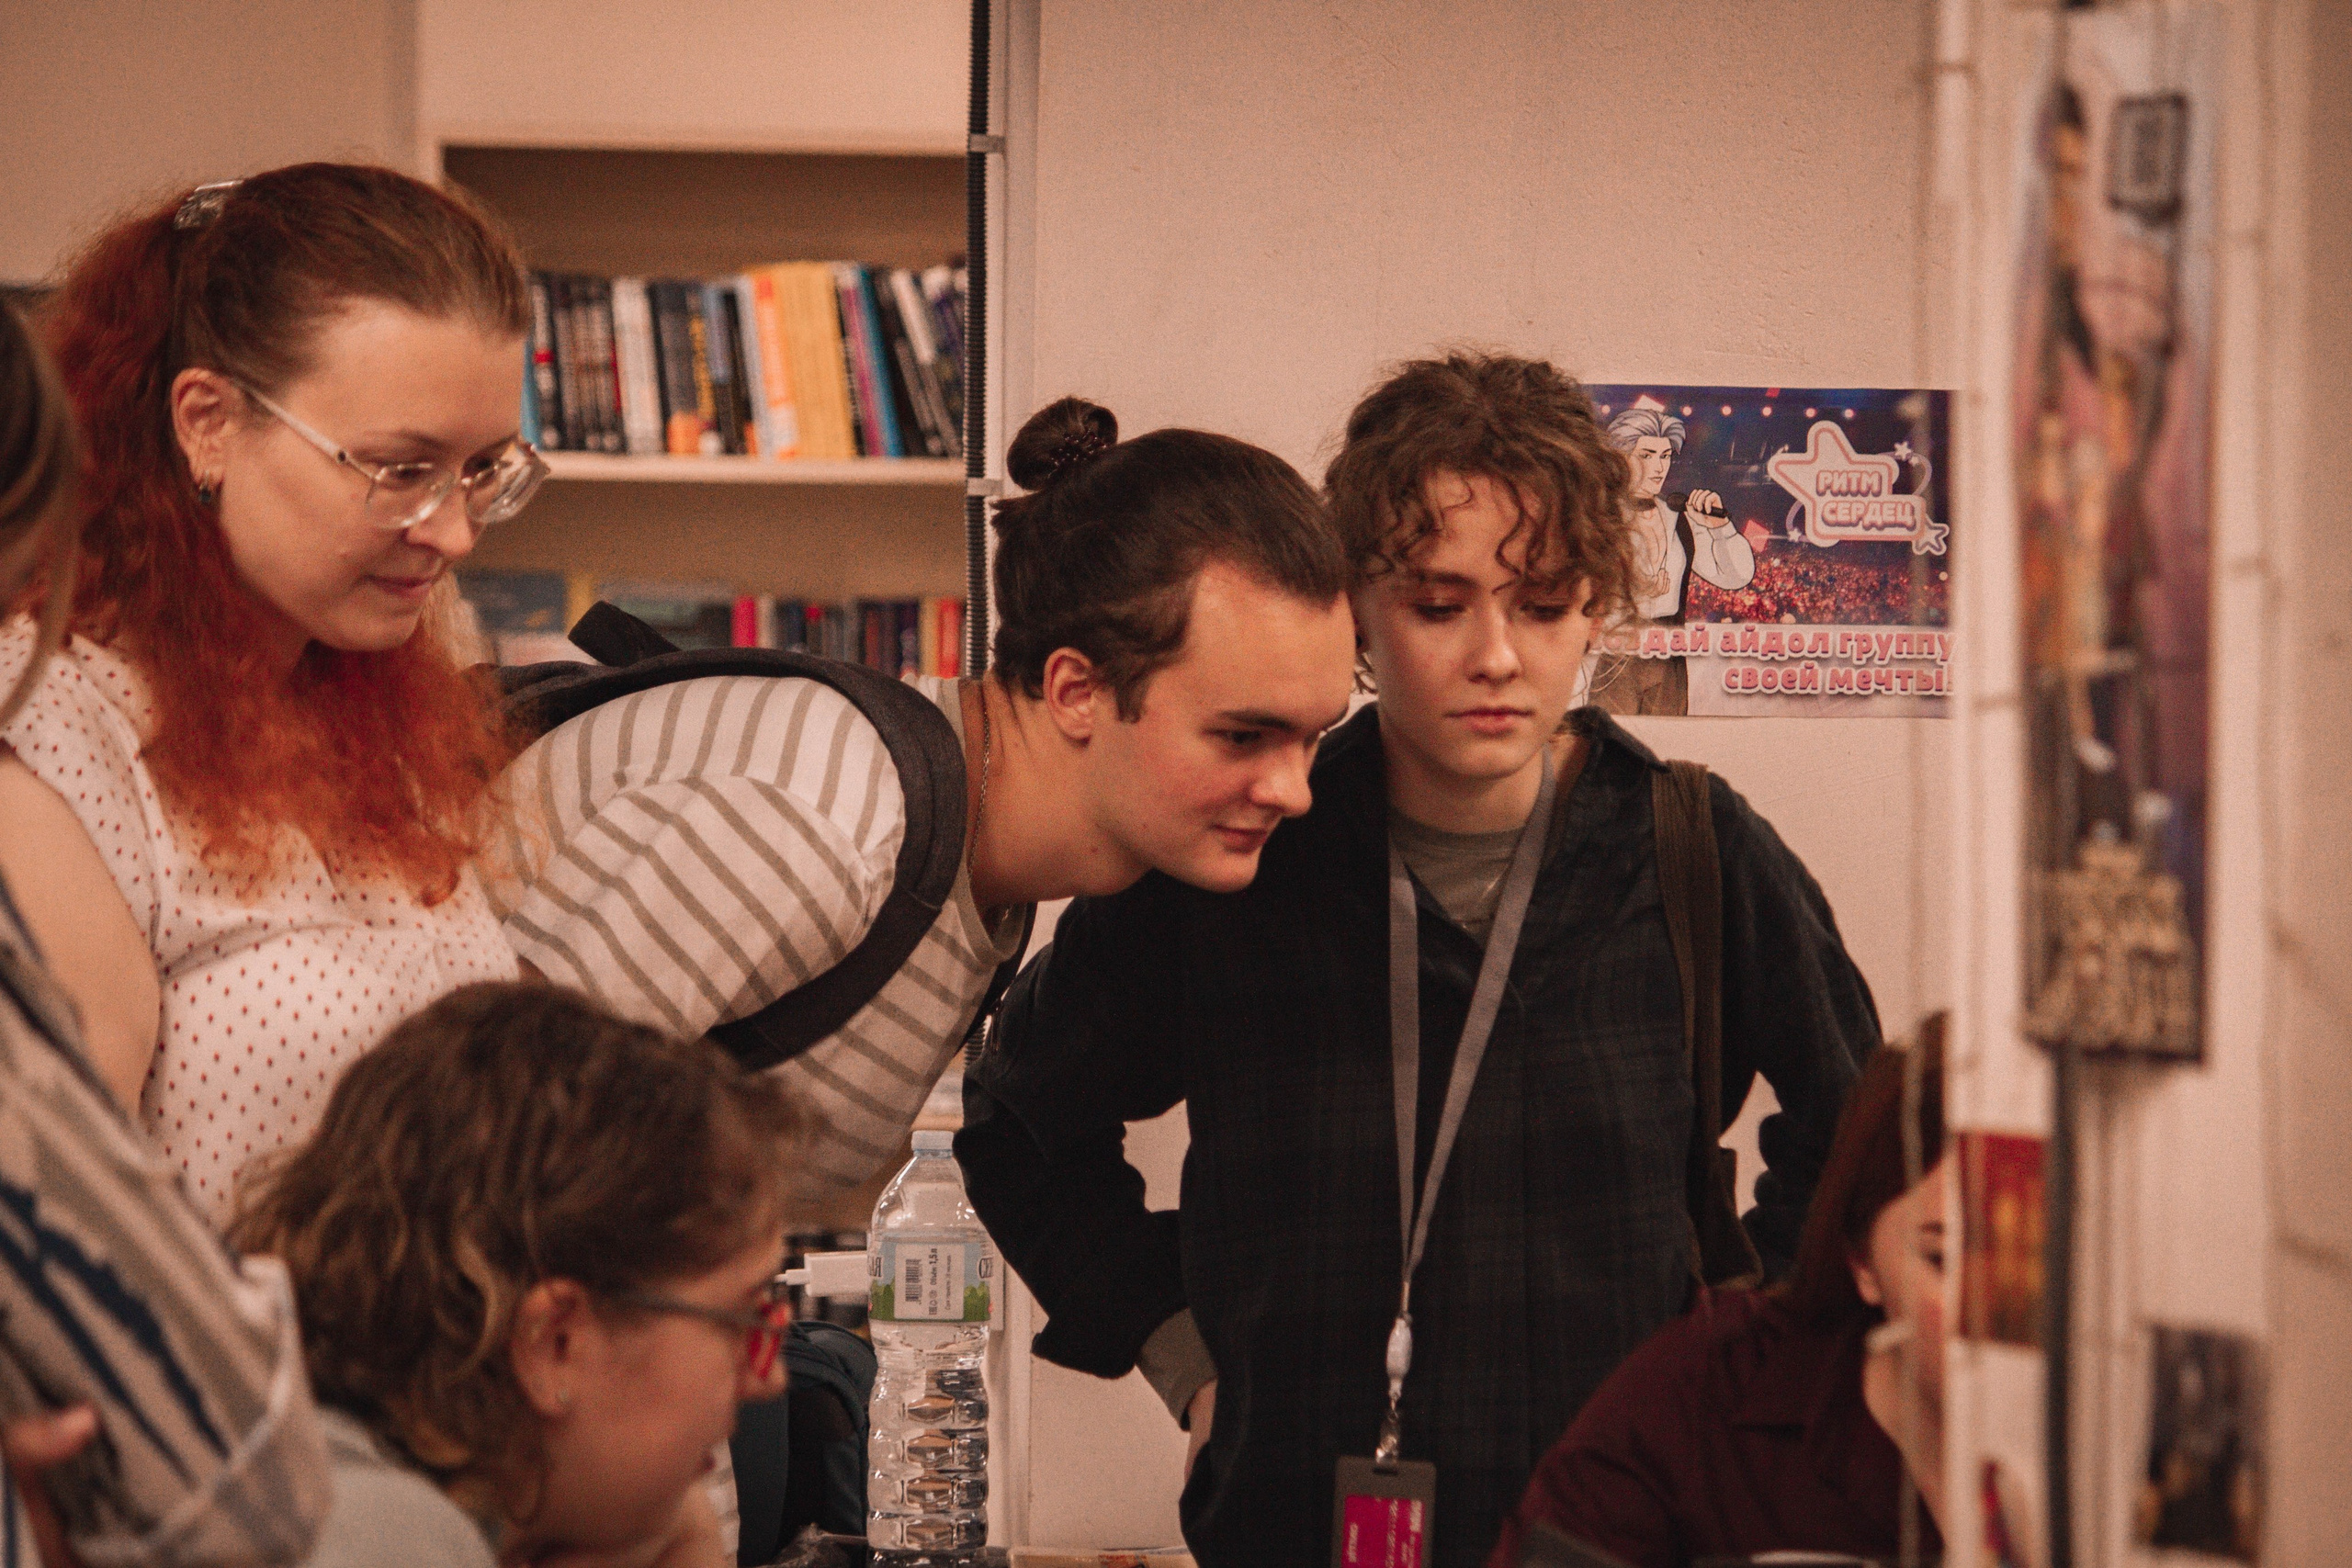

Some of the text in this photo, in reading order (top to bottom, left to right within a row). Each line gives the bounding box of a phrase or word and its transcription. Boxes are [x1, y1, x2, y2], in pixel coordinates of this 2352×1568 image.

[1815, 469, 1883, 497] РИТМ
[1821, 500, 1917, 531] СЕРДЕЦ
[1720, 624, 1830, 657] айдол
[1724, 661, 1820, 690] своей
